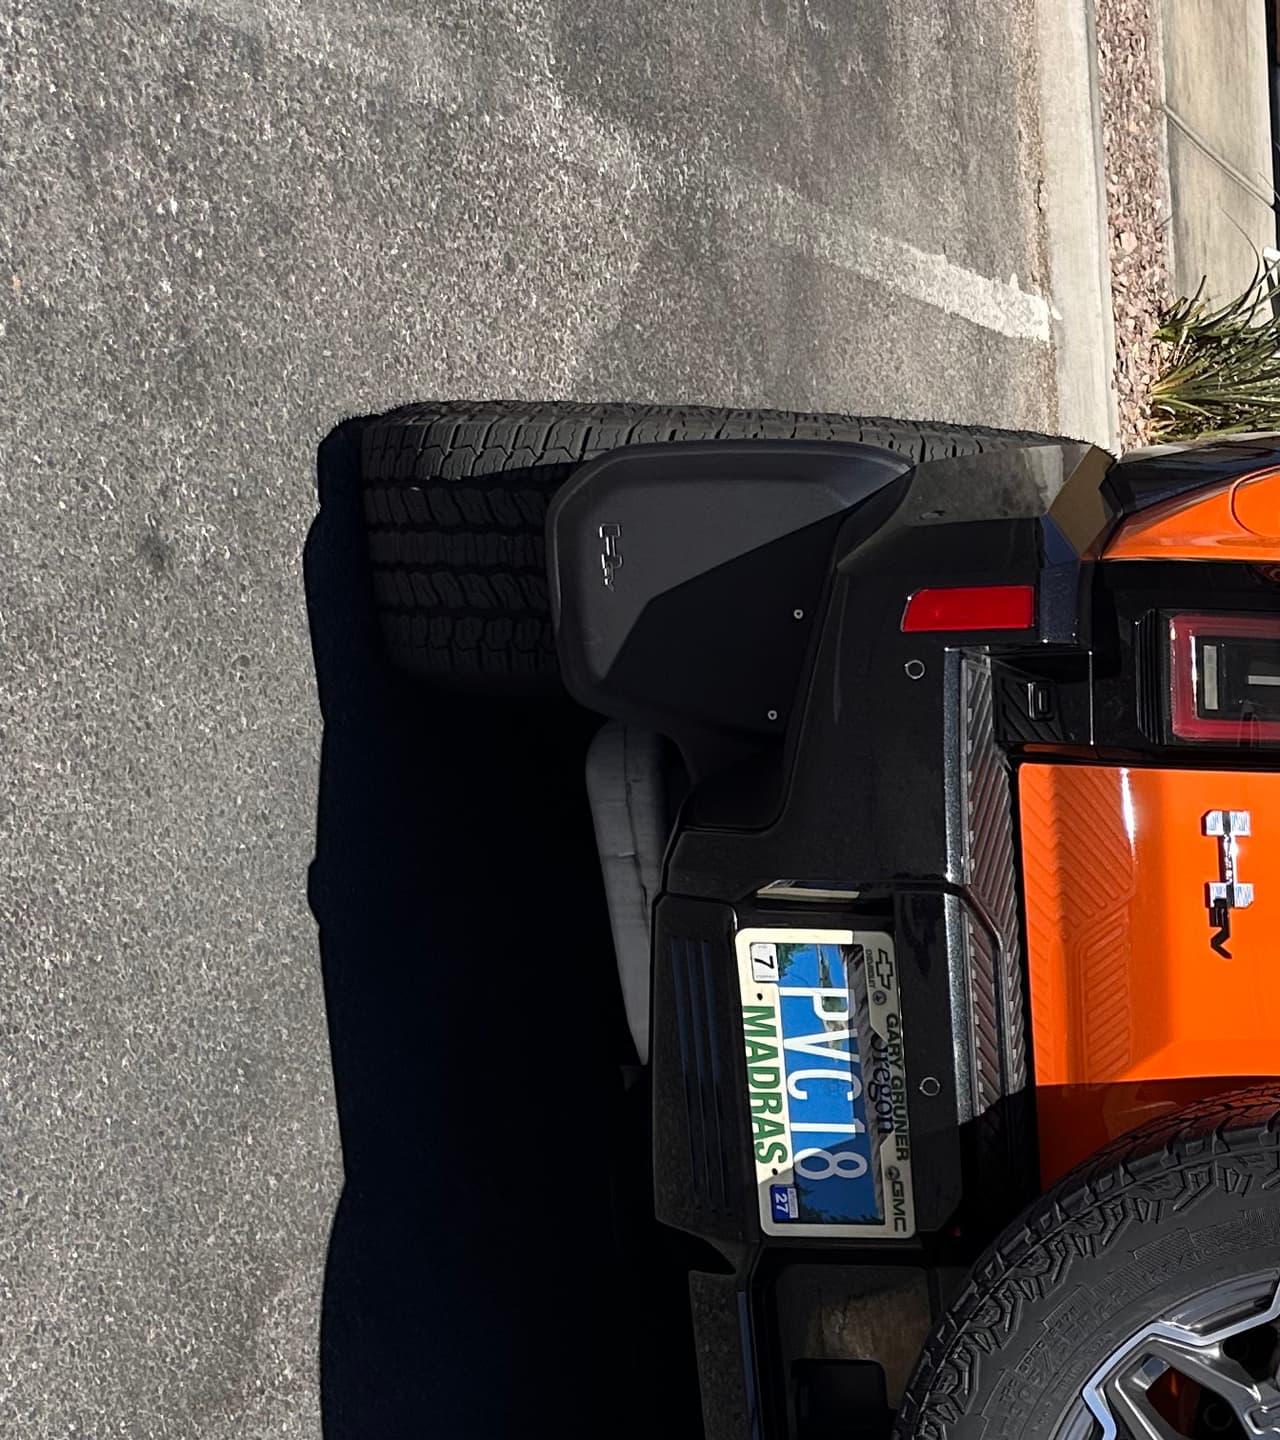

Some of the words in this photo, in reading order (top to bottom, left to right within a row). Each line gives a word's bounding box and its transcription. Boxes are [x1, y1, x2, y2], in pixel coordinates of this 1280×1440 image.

[753, 954, 775, 969] 7
[885, 1013, 904, 1073] GARY
[742, 1005, 789, 1164] MADRAS
[777, 986, 869, 1181] PVC18
[891, 1075, 910, 1161] GRUNER
[774, 1193, 788, 1213] 27
[892, 1180, 907, 1233] GMC
